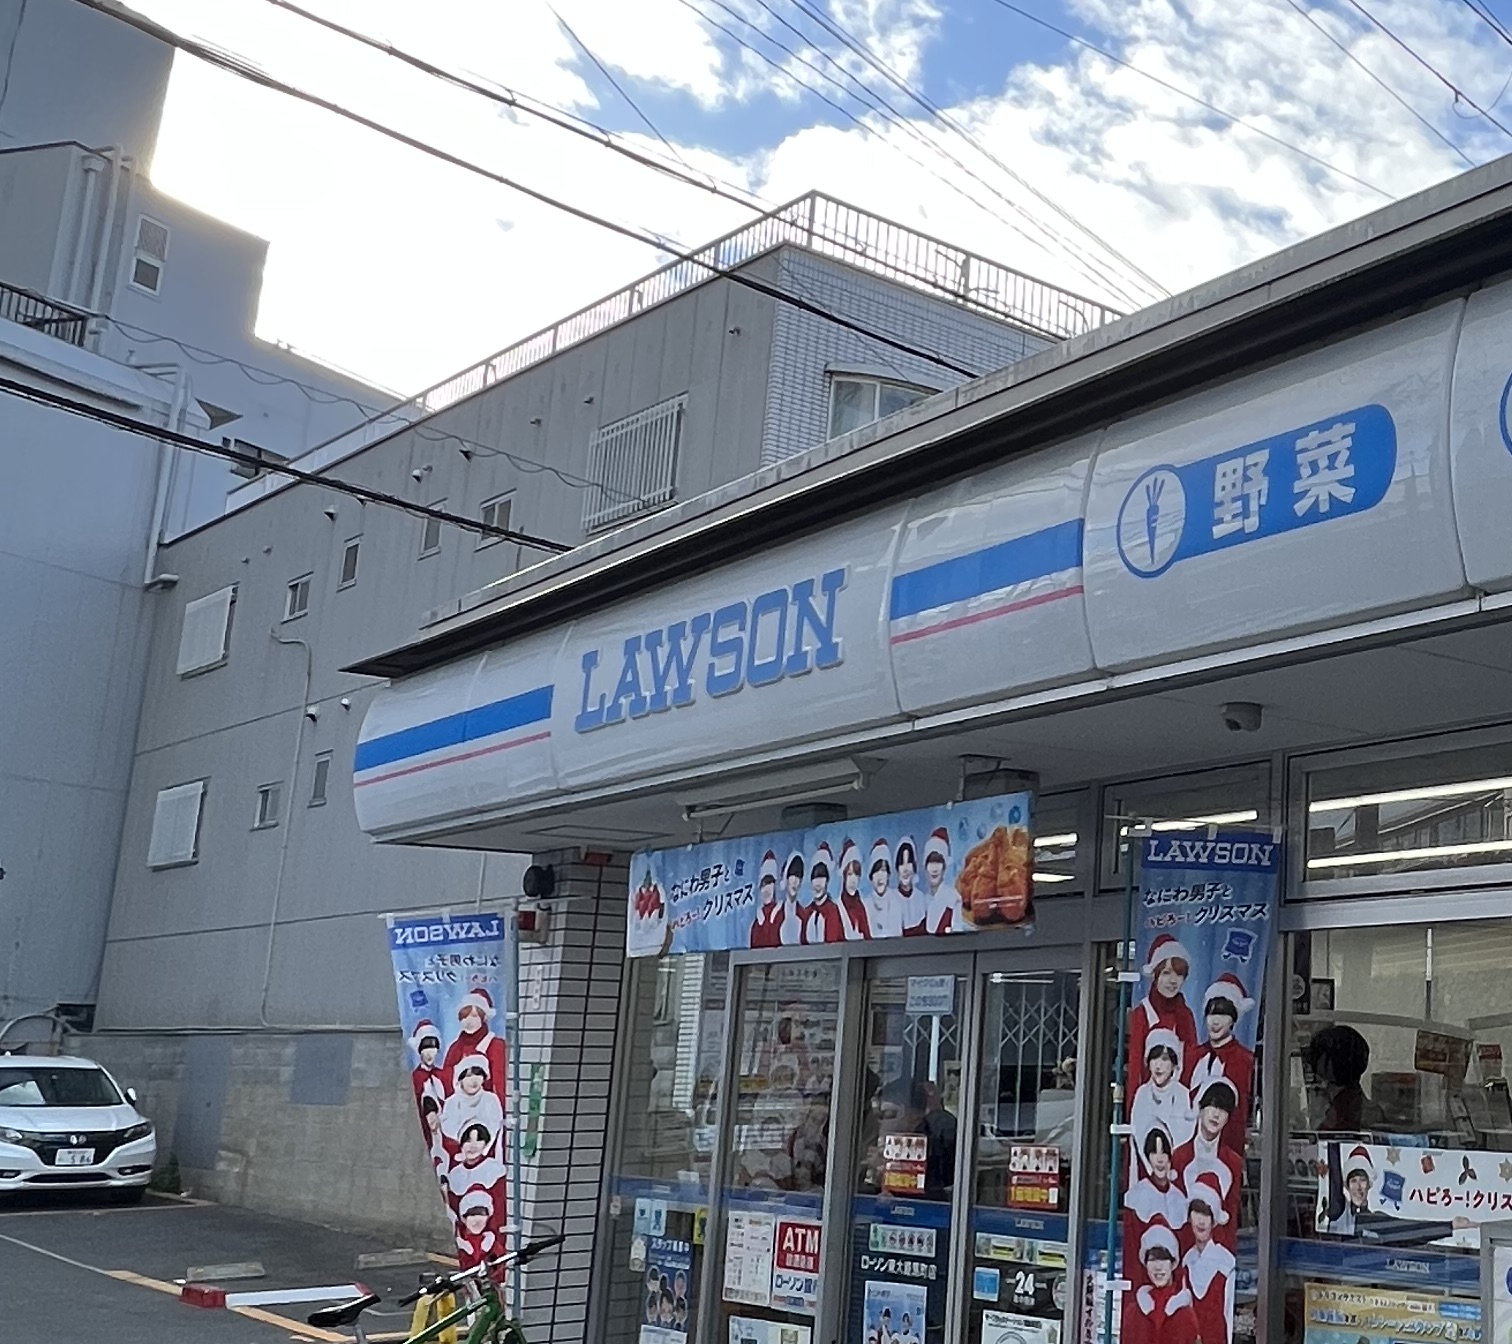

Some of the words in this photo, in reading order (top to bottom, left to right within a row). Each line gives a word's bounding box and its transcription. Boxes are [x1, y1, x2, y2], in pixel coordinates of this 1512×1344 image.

[1211, 420, 1358, 540] 野菜
[573, 566, 849, 735] LAWSON
[1147, 839, 1274, 866] LAWSON
[1142, 881, 1233, 907] なにわ男子と
[782, 1226, 820, 1255] ATM
[1014, 1270, 1036, 1296] 24
